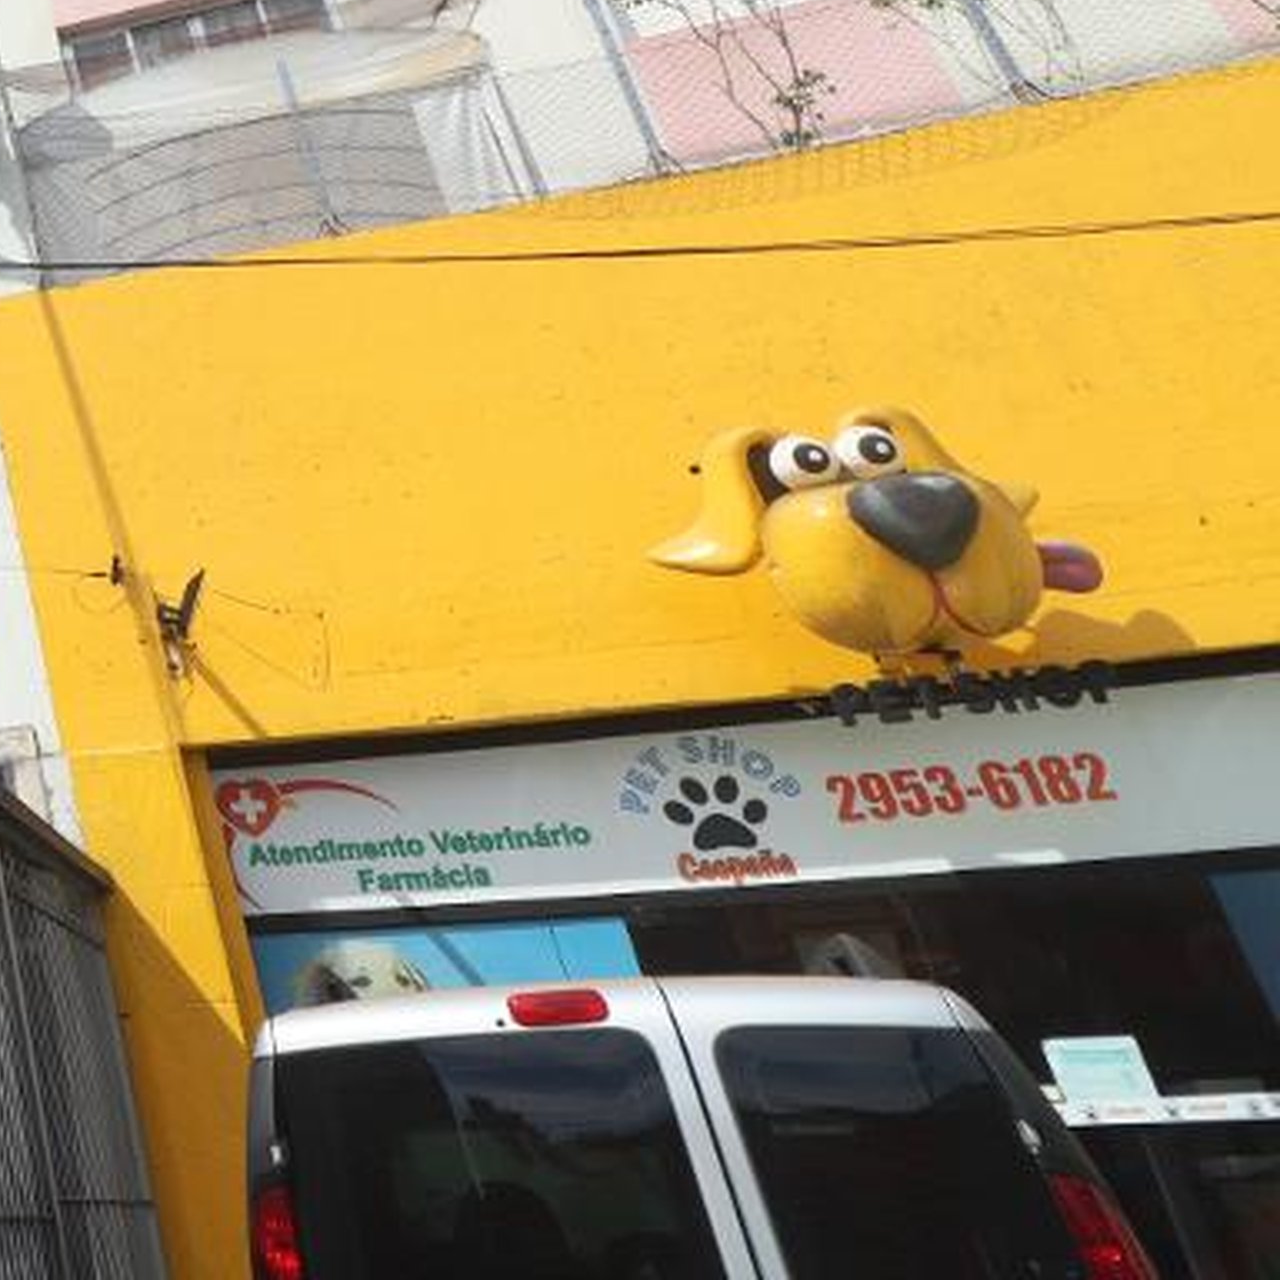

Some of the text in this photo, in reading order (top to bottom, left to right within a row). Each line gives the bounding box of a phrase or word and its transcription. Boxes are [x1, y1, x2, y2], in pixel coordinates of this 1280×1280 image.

[831, 658, 1118, 727] PET SHOP
[618, 735, 802, 815] PET SHOP
[825, 752, 1118, 823] 2953-6182
[248, 821, 592, 868] Atendimento Veterinário
[357, 862, 493, 894] Farmácia
